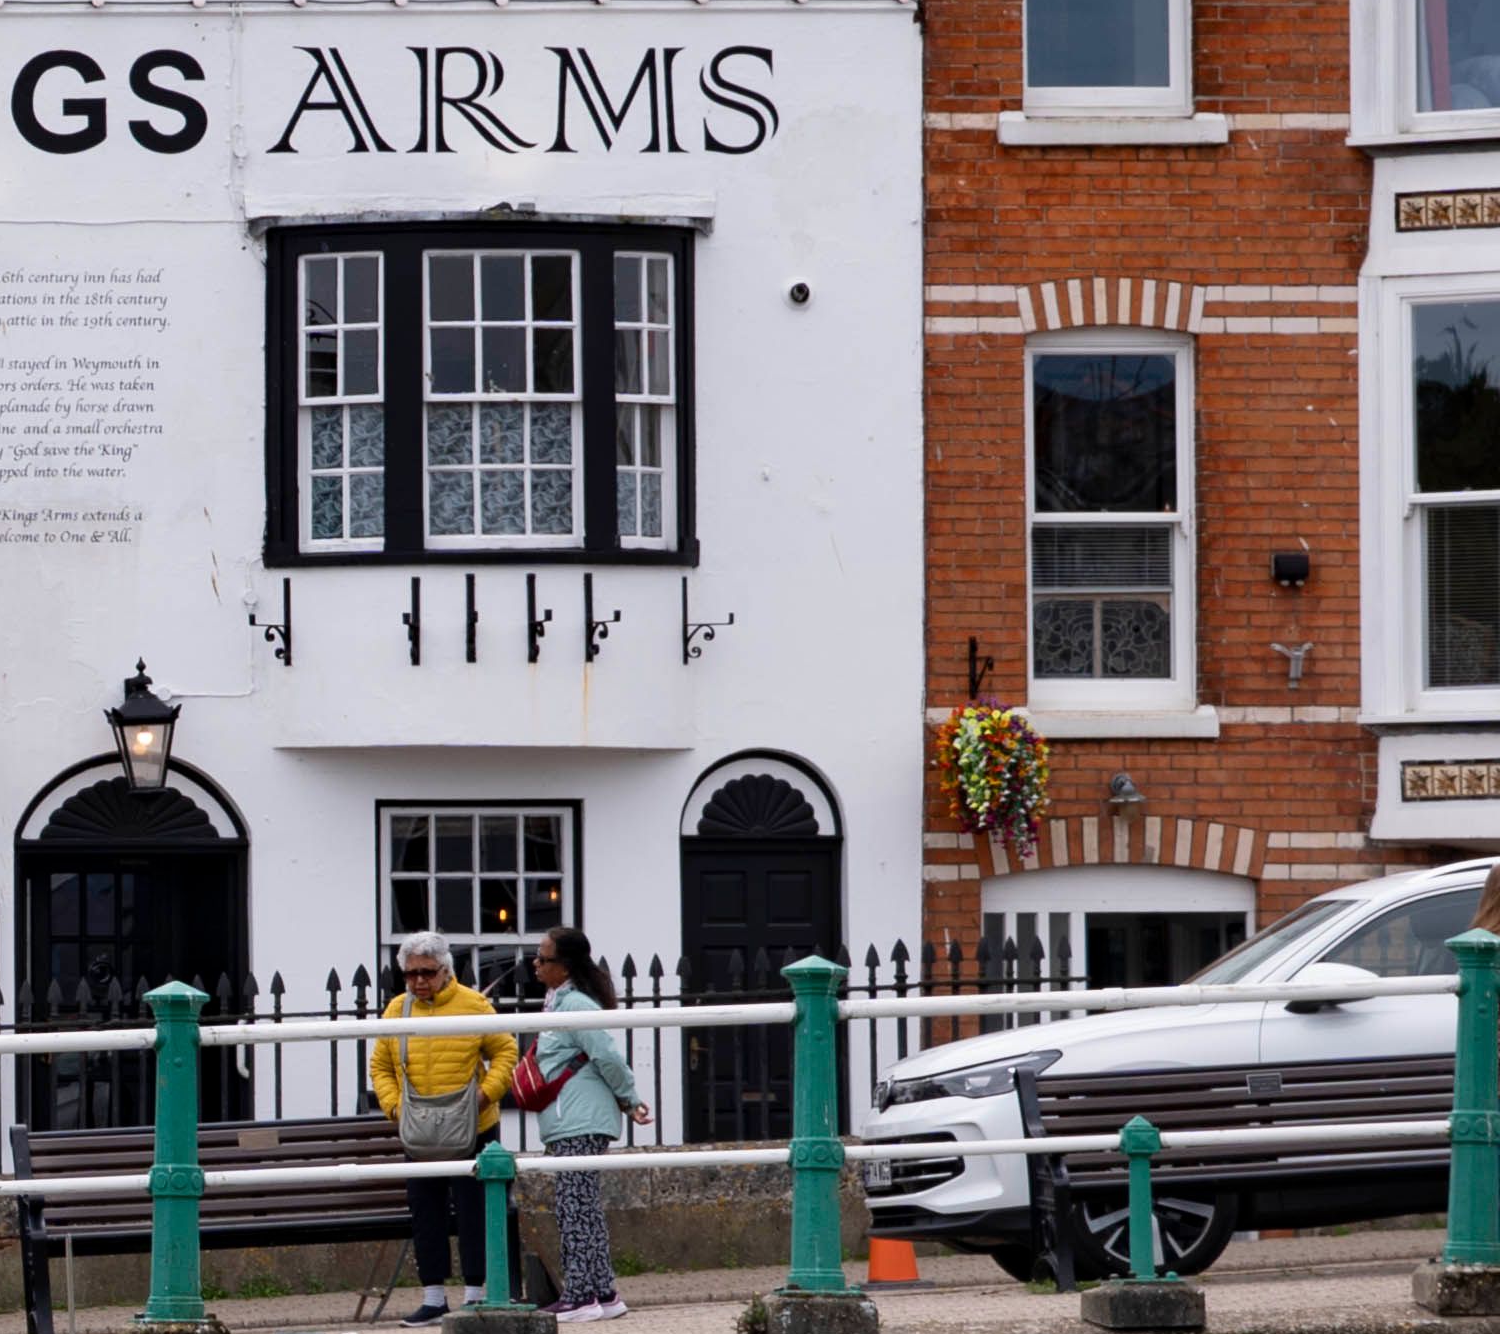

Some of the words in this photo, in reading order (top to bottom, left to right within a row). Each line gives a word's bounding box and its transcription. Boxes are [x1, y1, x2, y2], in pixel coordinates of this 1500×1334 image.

[267, 46, 778, 154] ARMS
[28, 274, 79, 292] century
[84, 275, 104, 283] inn
[110, 268, 131, 283] has
[137, 269, 163, 283] had
[43, 294, 55, 304] in
[60, 289, 79, 304] the
[85, 290, 113, 305] 18th
[117, 295, 167, 311] century
[7, 316, 36, 326] attic
[42, 315, 53, 326] in
[60, 312, 78, 326] the
[84, 312, 112, 329] 19th
[116, 316, 169, 332] century.
